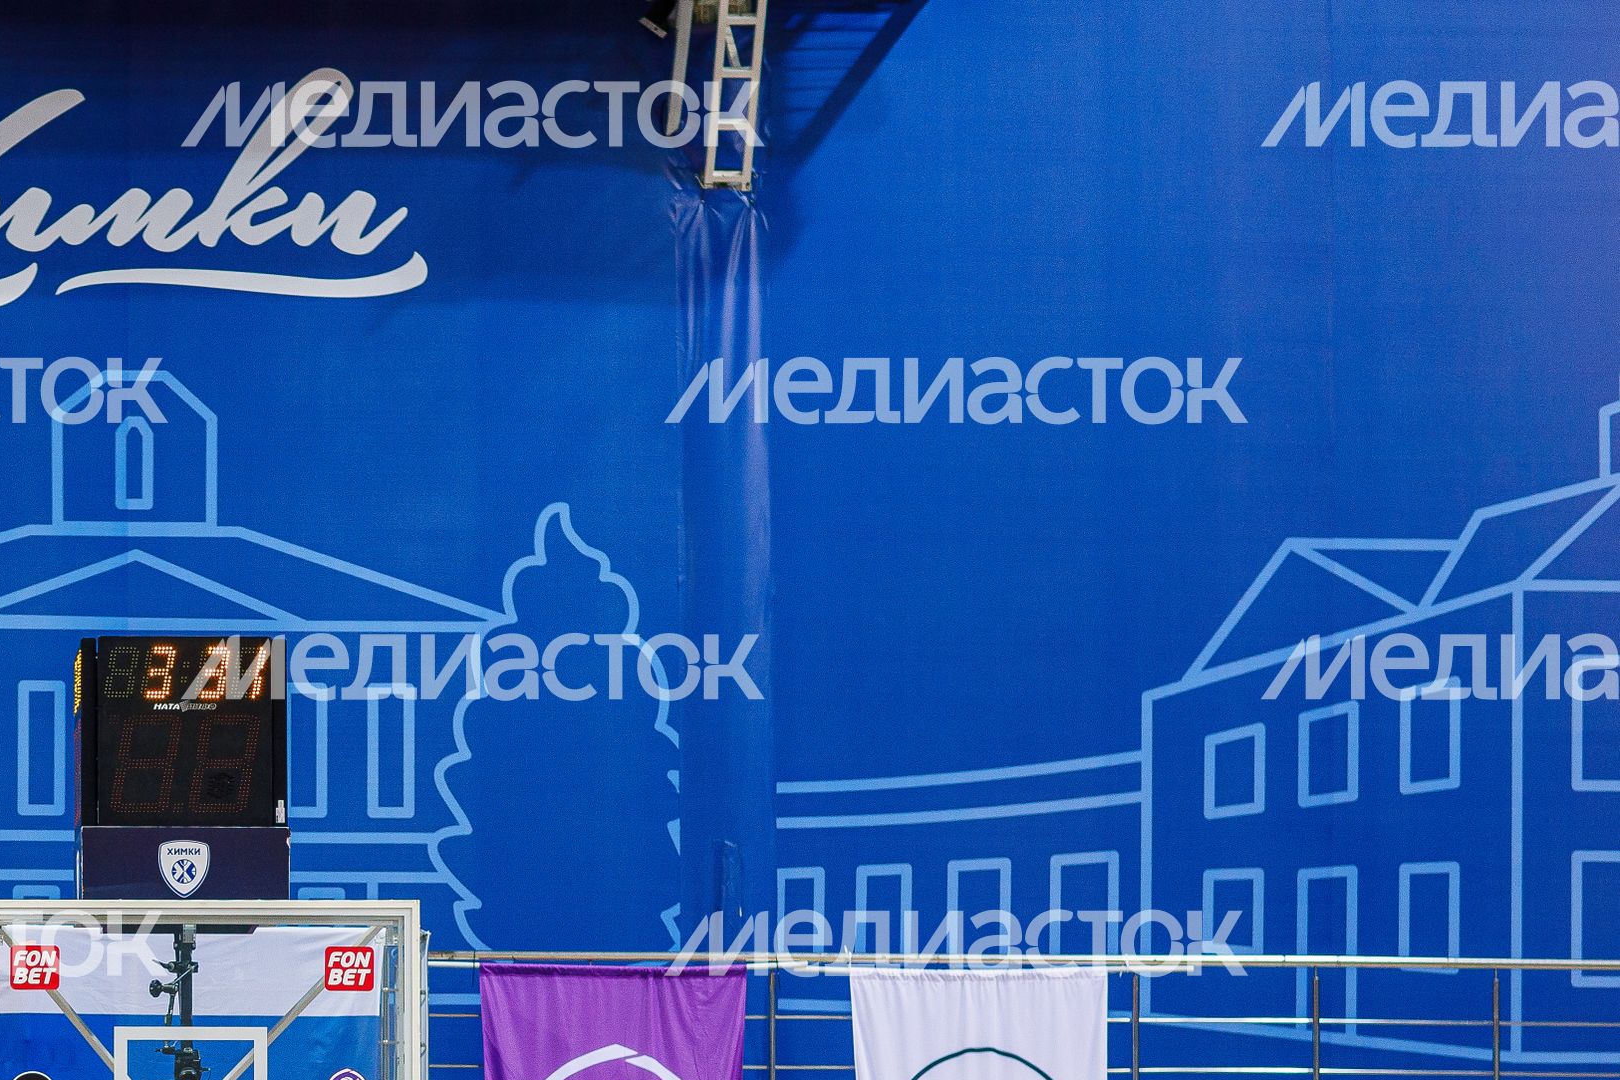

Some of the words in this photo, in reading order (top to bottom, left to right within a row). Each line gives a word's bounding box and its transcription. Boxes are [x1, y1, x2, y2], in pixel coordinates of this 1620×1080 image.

[166, 847, 201, 856] ХИМКИ
[13, 950, 57, 967] FON
[328, 951, 371, 969] FON
[13, 967, 57, 985] BET
[327, 968, 371, 987] BET
